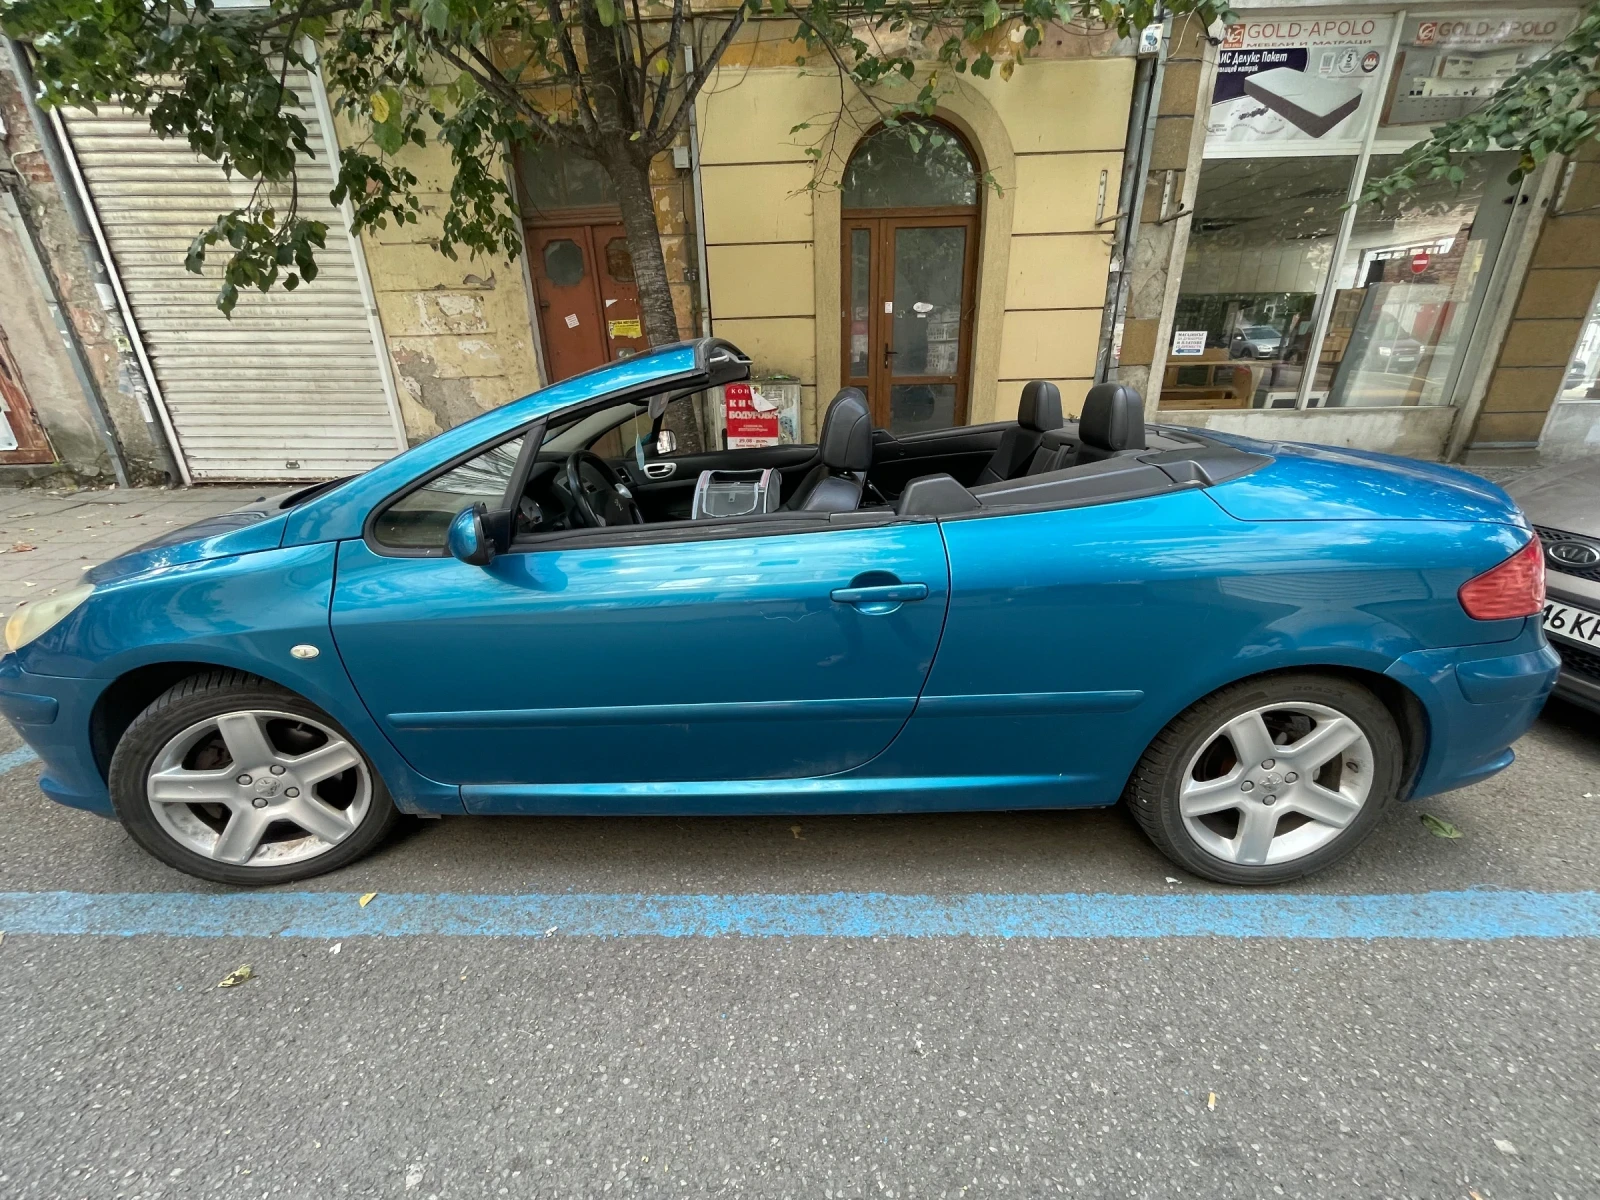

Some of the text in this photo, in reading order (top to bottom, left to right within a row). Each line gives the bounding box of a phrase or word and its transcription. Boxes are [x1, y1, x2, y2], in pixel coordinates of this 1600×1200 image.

[1248, 20, 1375, 39] GOLD-APOLO
[1438, 21, 1557, 37] GOLD-APOLO
[1231, 51, 1260, 66] Делукс
[1261, 51, 1288, 63] Покет
[1346, 53, 1353, 62] 5
[729, 399, 753, 408] КИЧ
[1557, 545, 1590, 563] KIA
